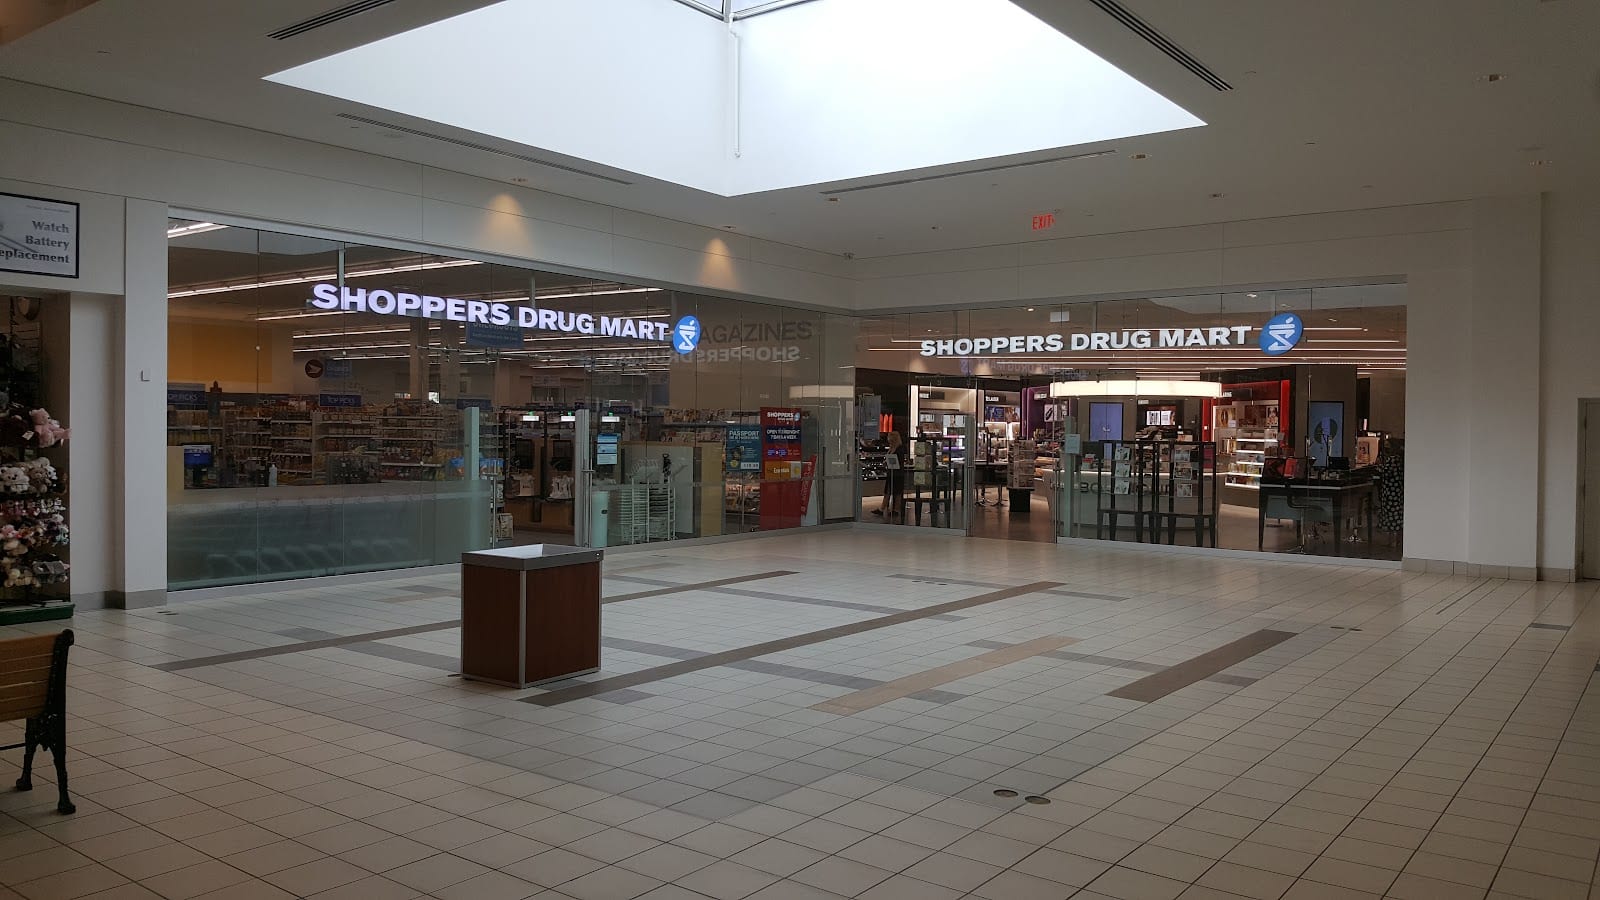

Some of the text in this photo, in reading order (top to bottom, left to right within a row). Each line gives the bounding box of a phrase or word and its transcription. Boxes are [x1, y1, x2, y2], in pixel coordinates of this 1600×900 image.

[32, 220, 70, 234] Watch
[1032, 214, 1053, 230] EXIT
[25, 235, 70, 251] Battery
[0, 249, 70, 263] eplacement
[311, 283, 670, 342] SHOPPERS DRUG MART
[701, 319, 812, 344] AGAZINES
[920, 326, 1253, 357] SHOPPERS DRUG MART
